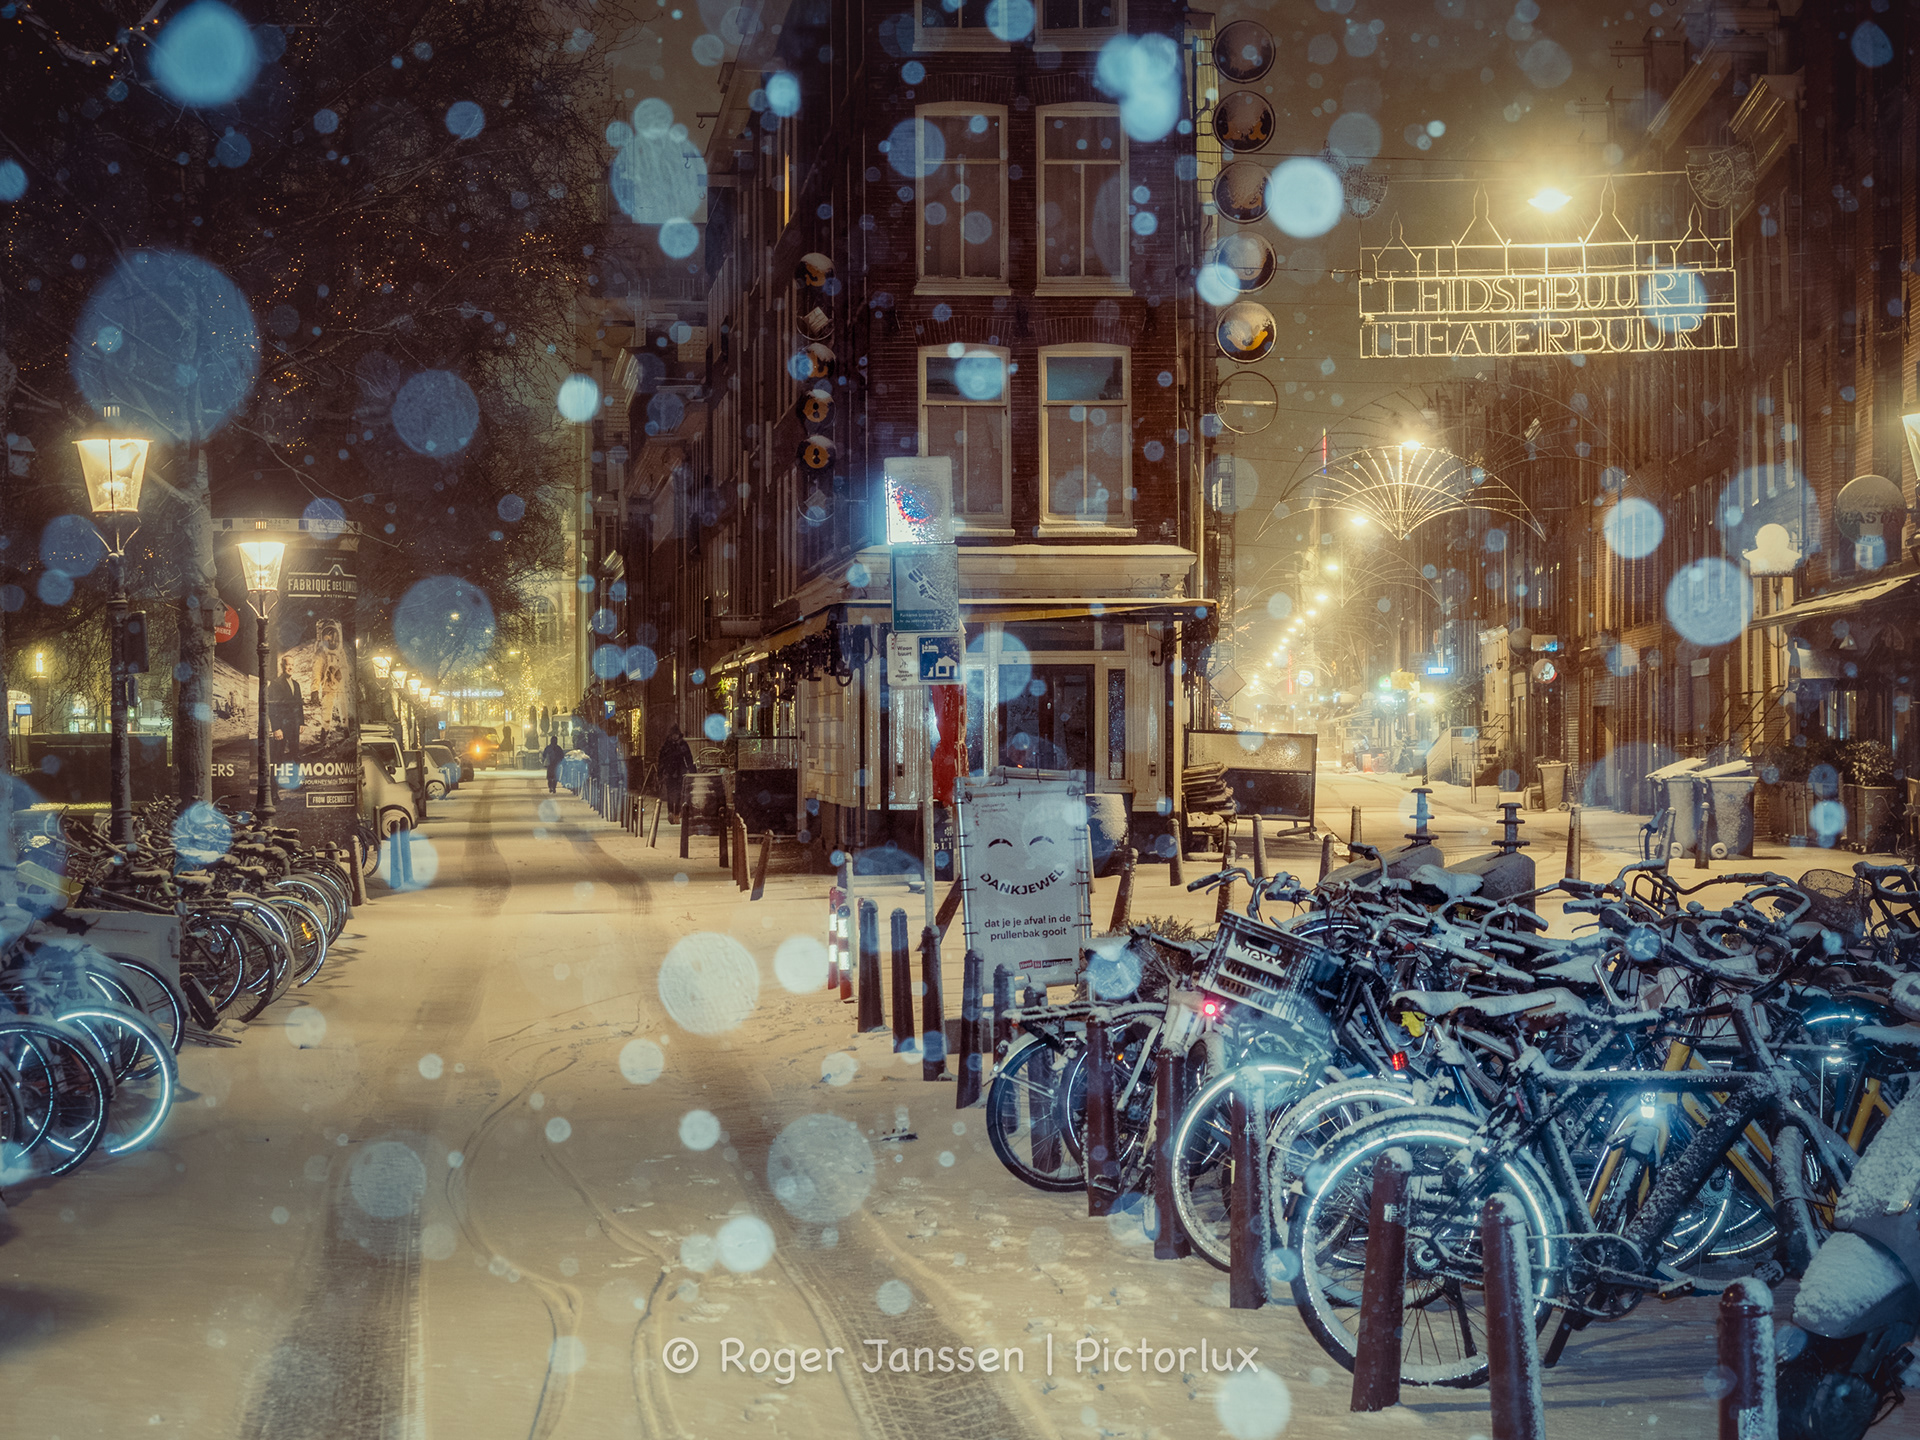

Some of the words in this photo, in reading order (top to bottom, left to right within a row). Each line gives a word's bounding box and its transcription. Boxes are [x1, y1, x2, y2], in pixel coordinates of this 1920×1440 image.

[1386, 271, 1708, 315] LEIDSEBUURT
[1367, 314, 1732, 358] THEATERBUURT
[287, 578, 331, 592] FABRIQUE
[211, 763, 235, 777] ERS
[270, 763, 294, 777] THE
[980, 869, 1065, 896] DANKJEWEL
[984, 919, 1000, 928] dat
[1002, 918, 1011, 928] je
[1013, 917, 1022, 928] je
[1024, 915, 1046, 925] afval
[1048, 915, 1057, 923] in
[1059, 914, 1071, 922] de
[990, 929, 1040, 942] prullenbak
[1042, 927, 1067, 938] gooit
